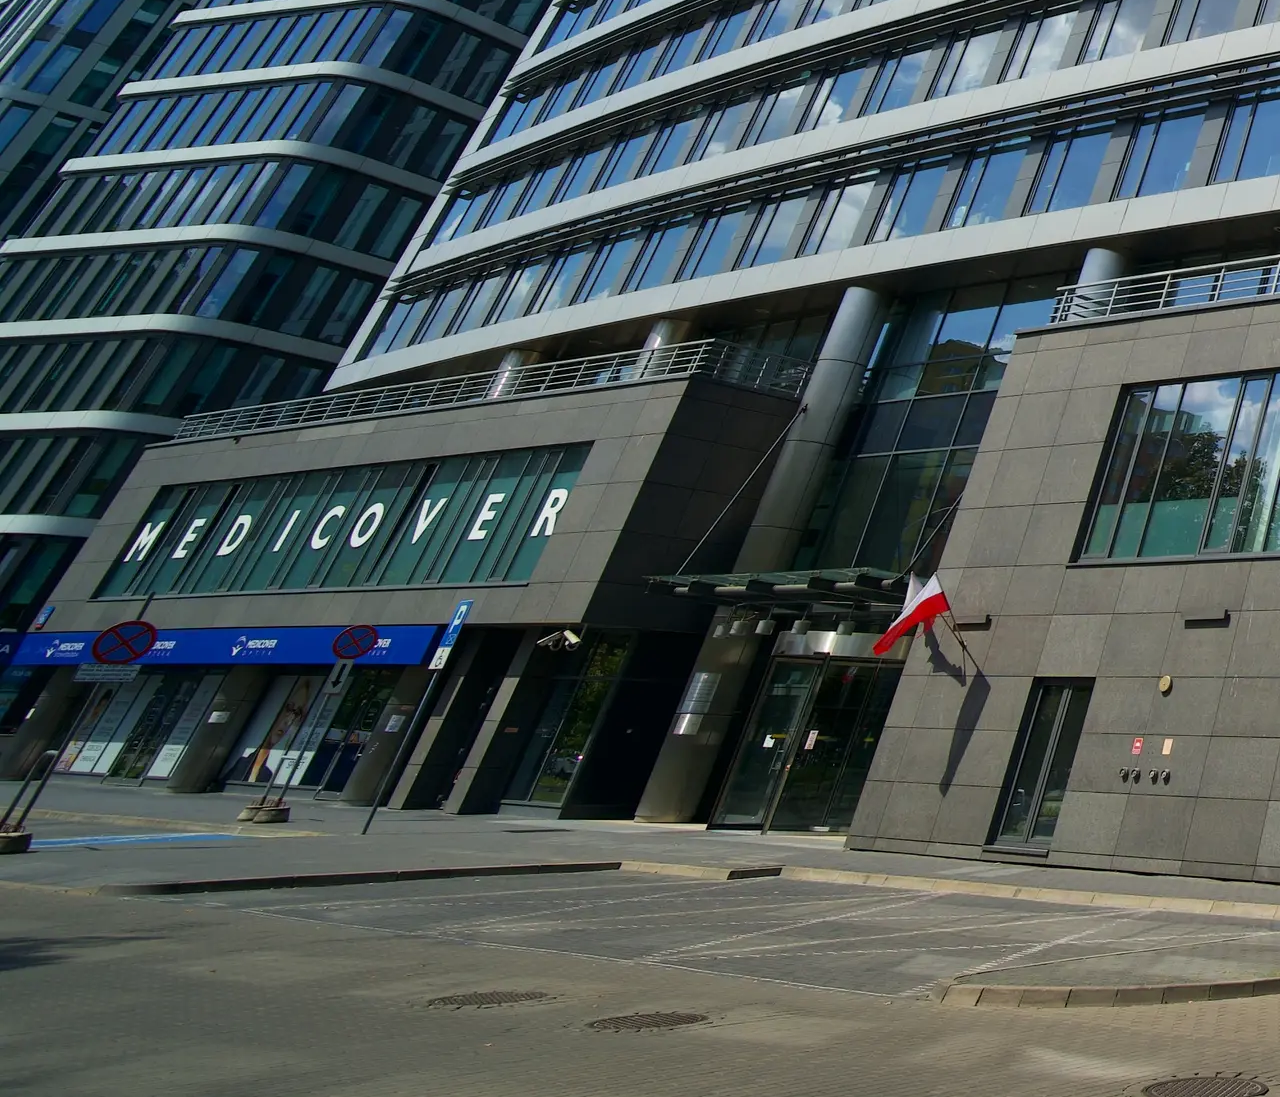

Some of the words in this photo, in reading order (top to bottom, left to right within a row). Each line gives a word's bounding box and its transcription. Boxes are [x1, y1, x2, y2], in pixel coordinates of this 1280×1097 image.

[123, 488, 568, 563] MEDICOVER
[448, 605, 468, 634] P
[246, 639, 278, 649] MEDICOVER
